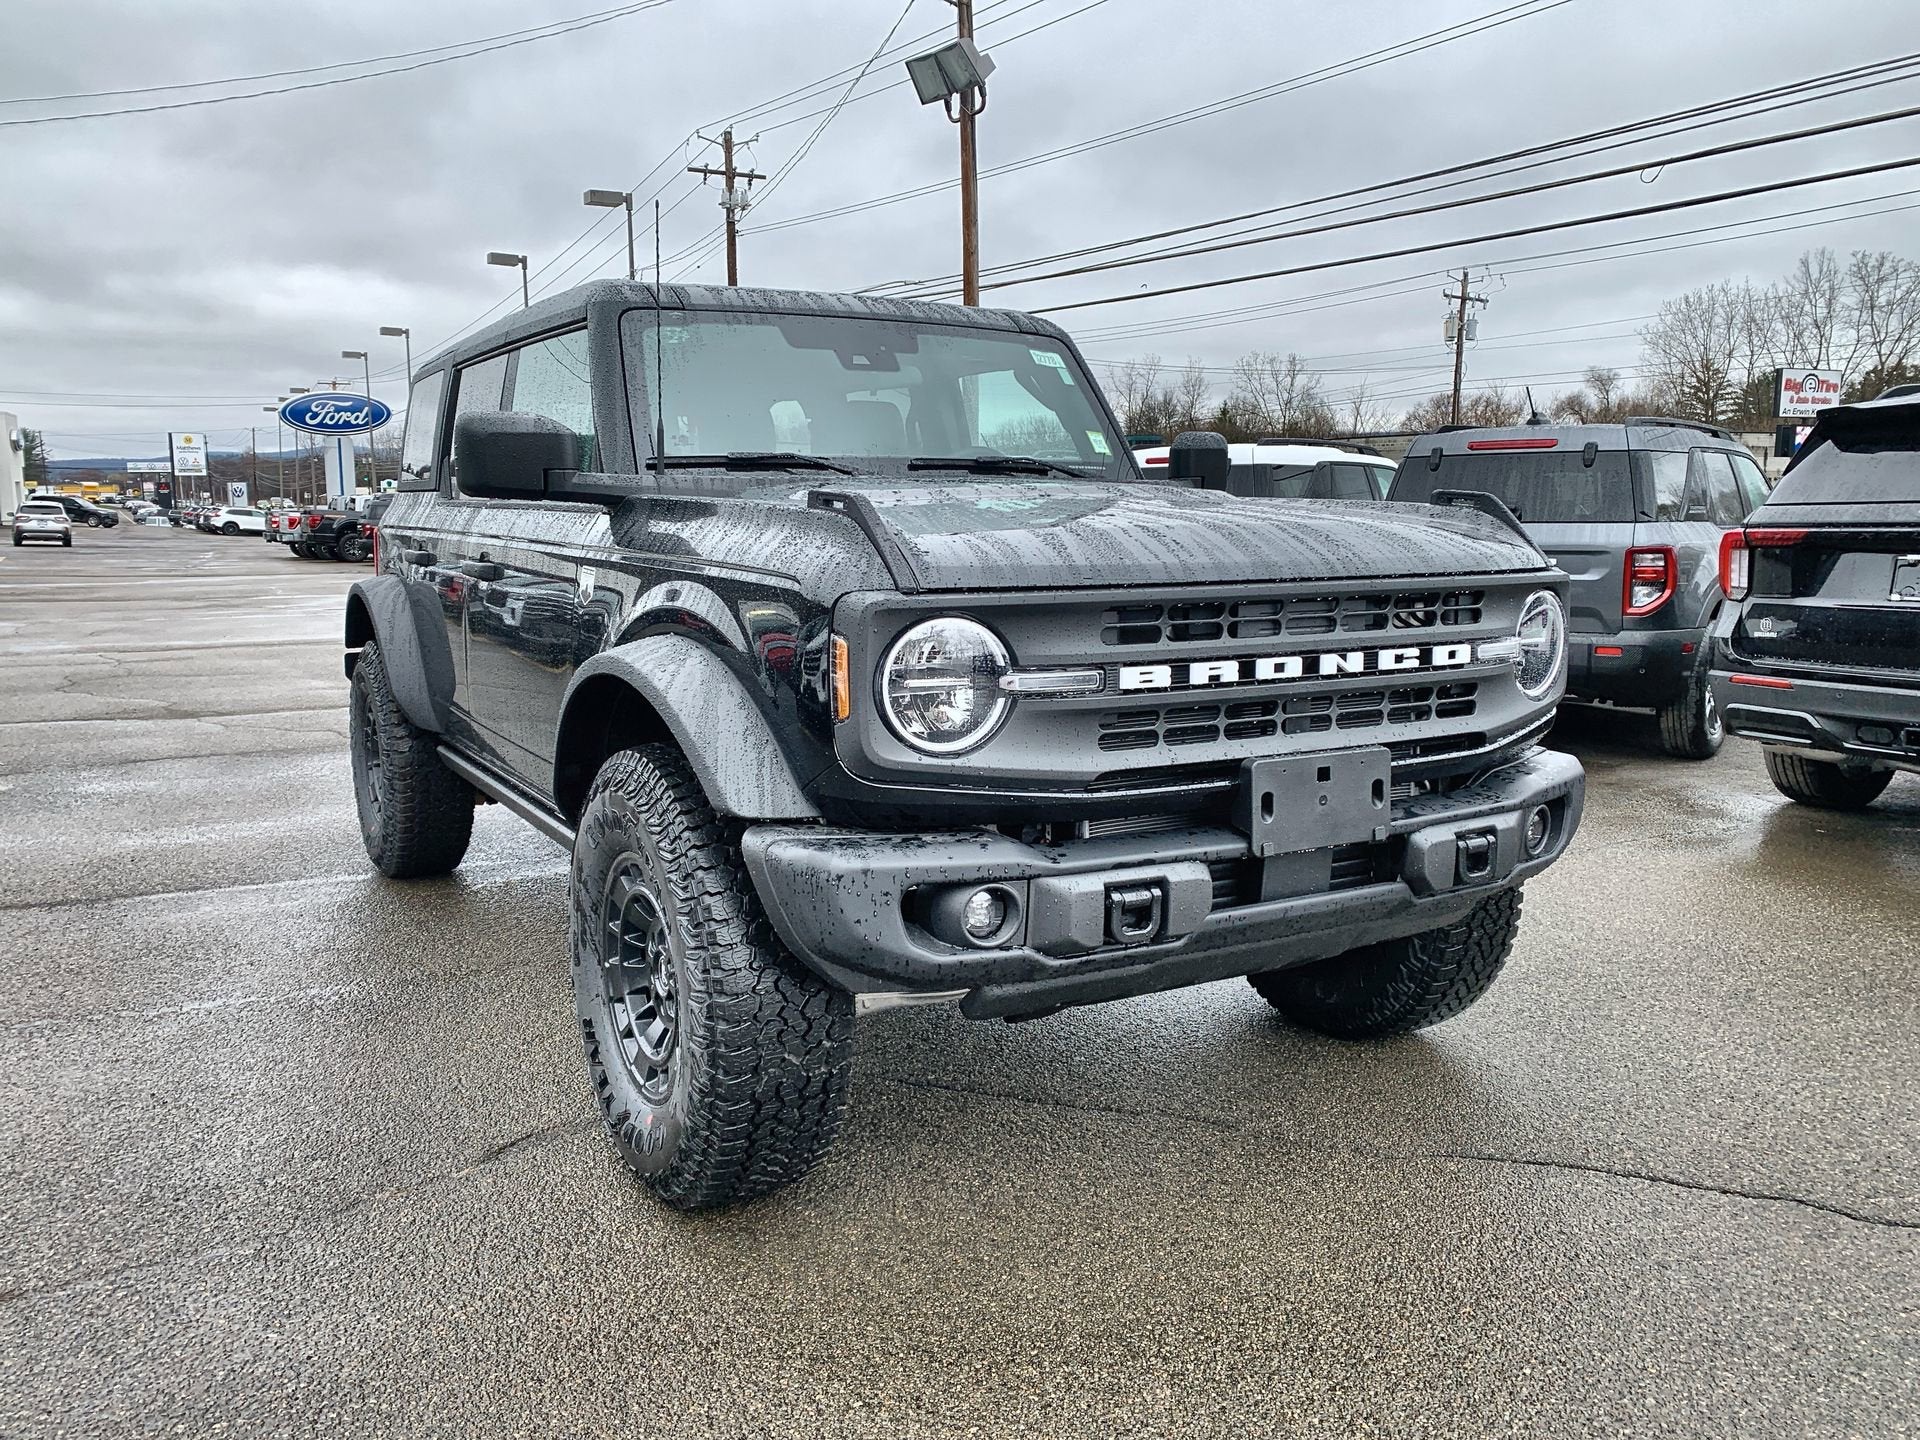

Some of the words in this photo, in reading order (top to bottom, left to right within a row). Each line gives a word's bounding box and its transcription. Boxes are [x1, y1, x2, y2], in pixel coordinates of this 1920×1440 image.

[1784, 378, 1802, 395] Big
[1820, 379, 1839, 394] Tire
[305, 400, 369, 425] Ford
[1782, 407, 1791, 415] An
[1792, 407, 1810, 415] Erwin
[1120, 644, 1471, 689] BRONCO
